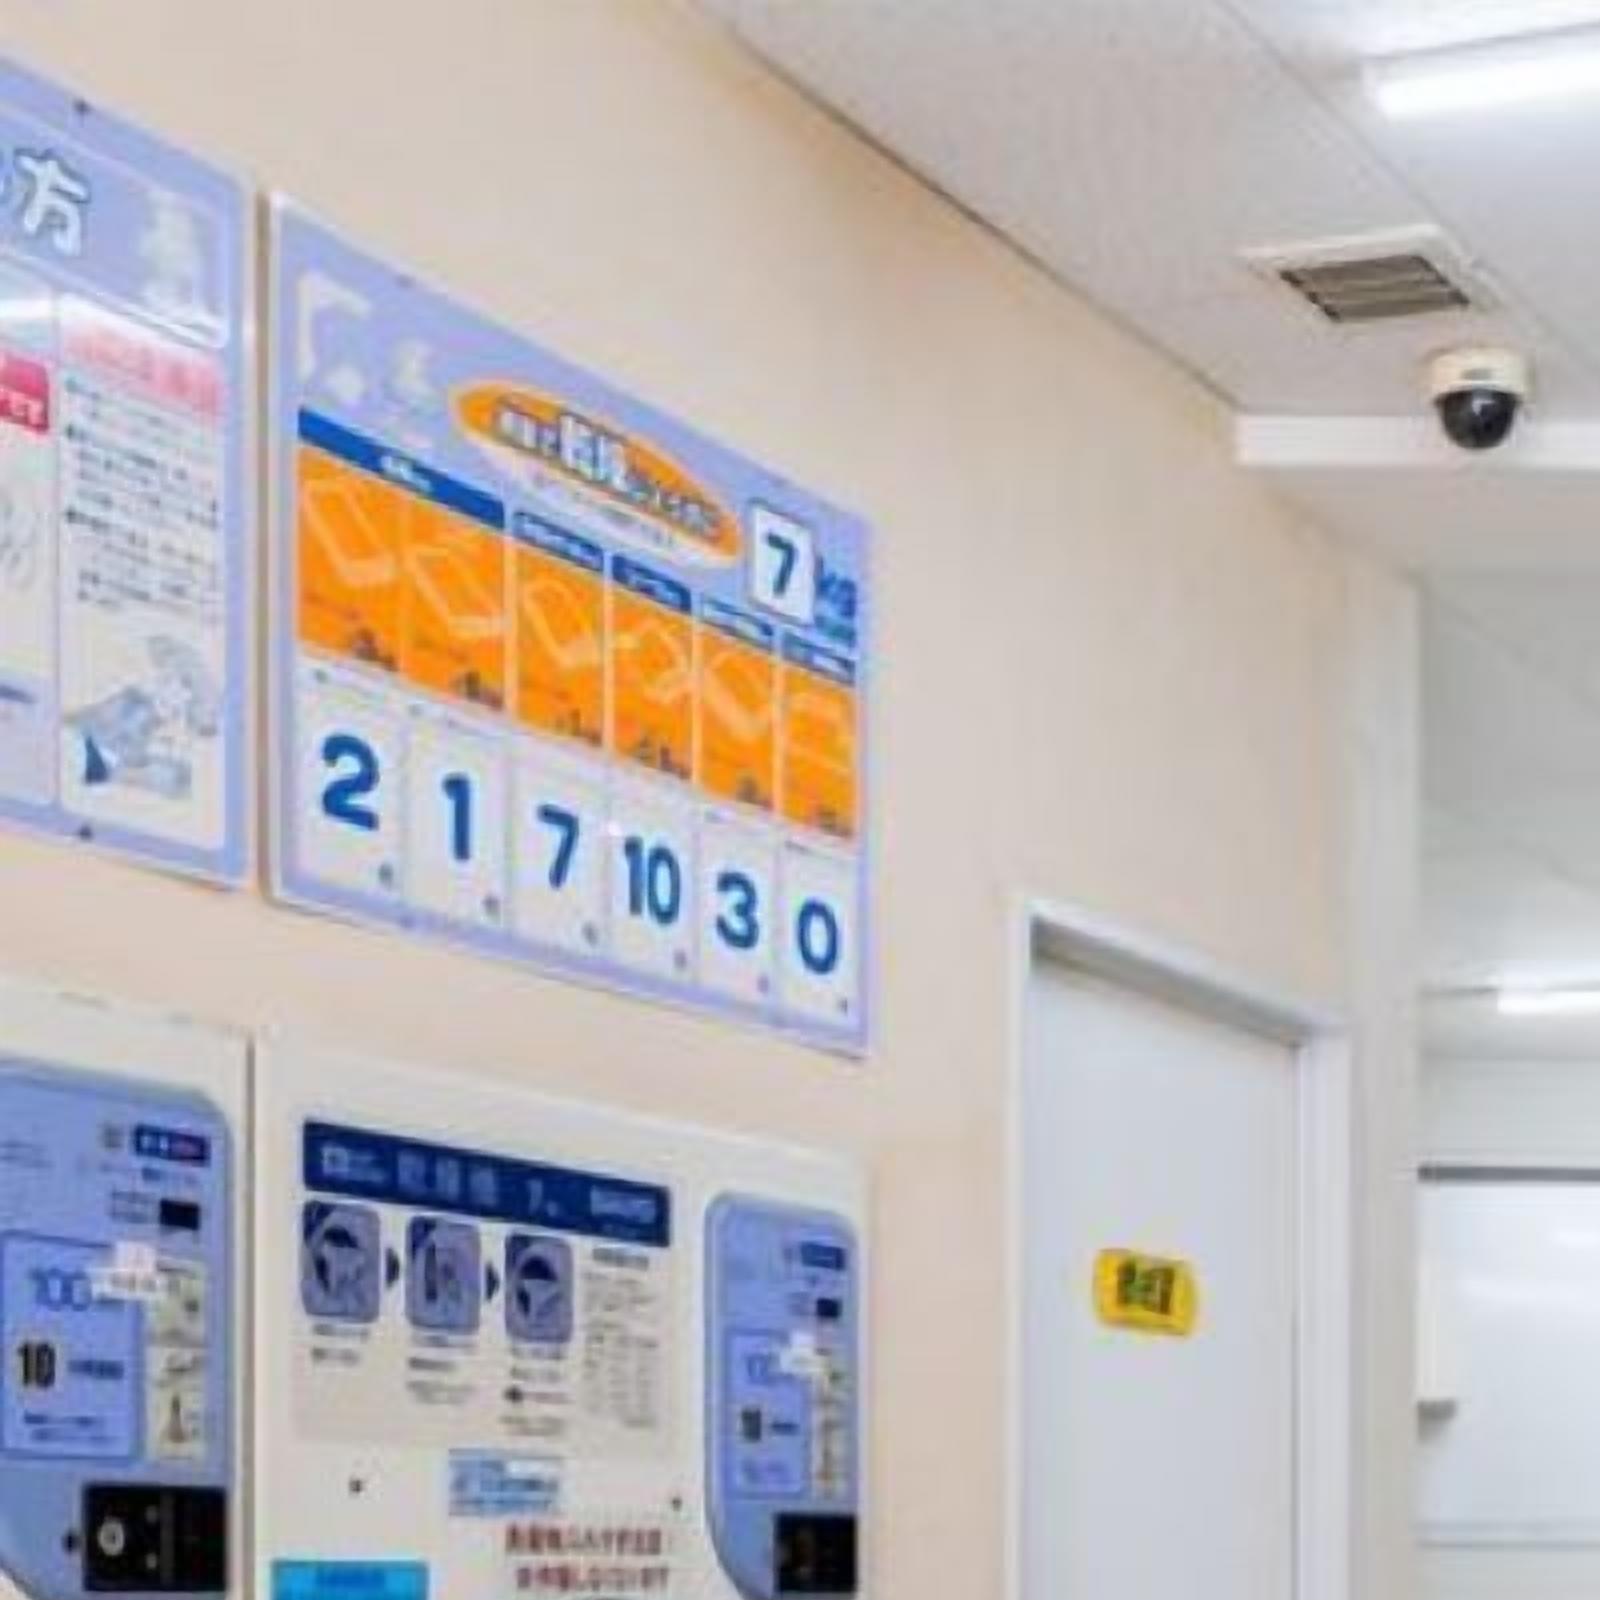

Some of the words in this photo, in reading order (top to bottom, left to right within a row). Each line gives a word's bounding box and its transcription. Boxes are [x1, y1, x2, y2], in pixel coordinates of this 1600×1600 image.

[0, 147, 91, 256] 方
[767, 532, 795, 599] 7
[322, 733, 379, 831] 2
[442, 773, 471, 861] 1
[537, 803, 580, 890] 7
[624, 836, 681, 926] 10
[716, 870, 759, 949] 3
[798, 899, 840, 976] 0
[17, 1341, 57, 1390] 10
